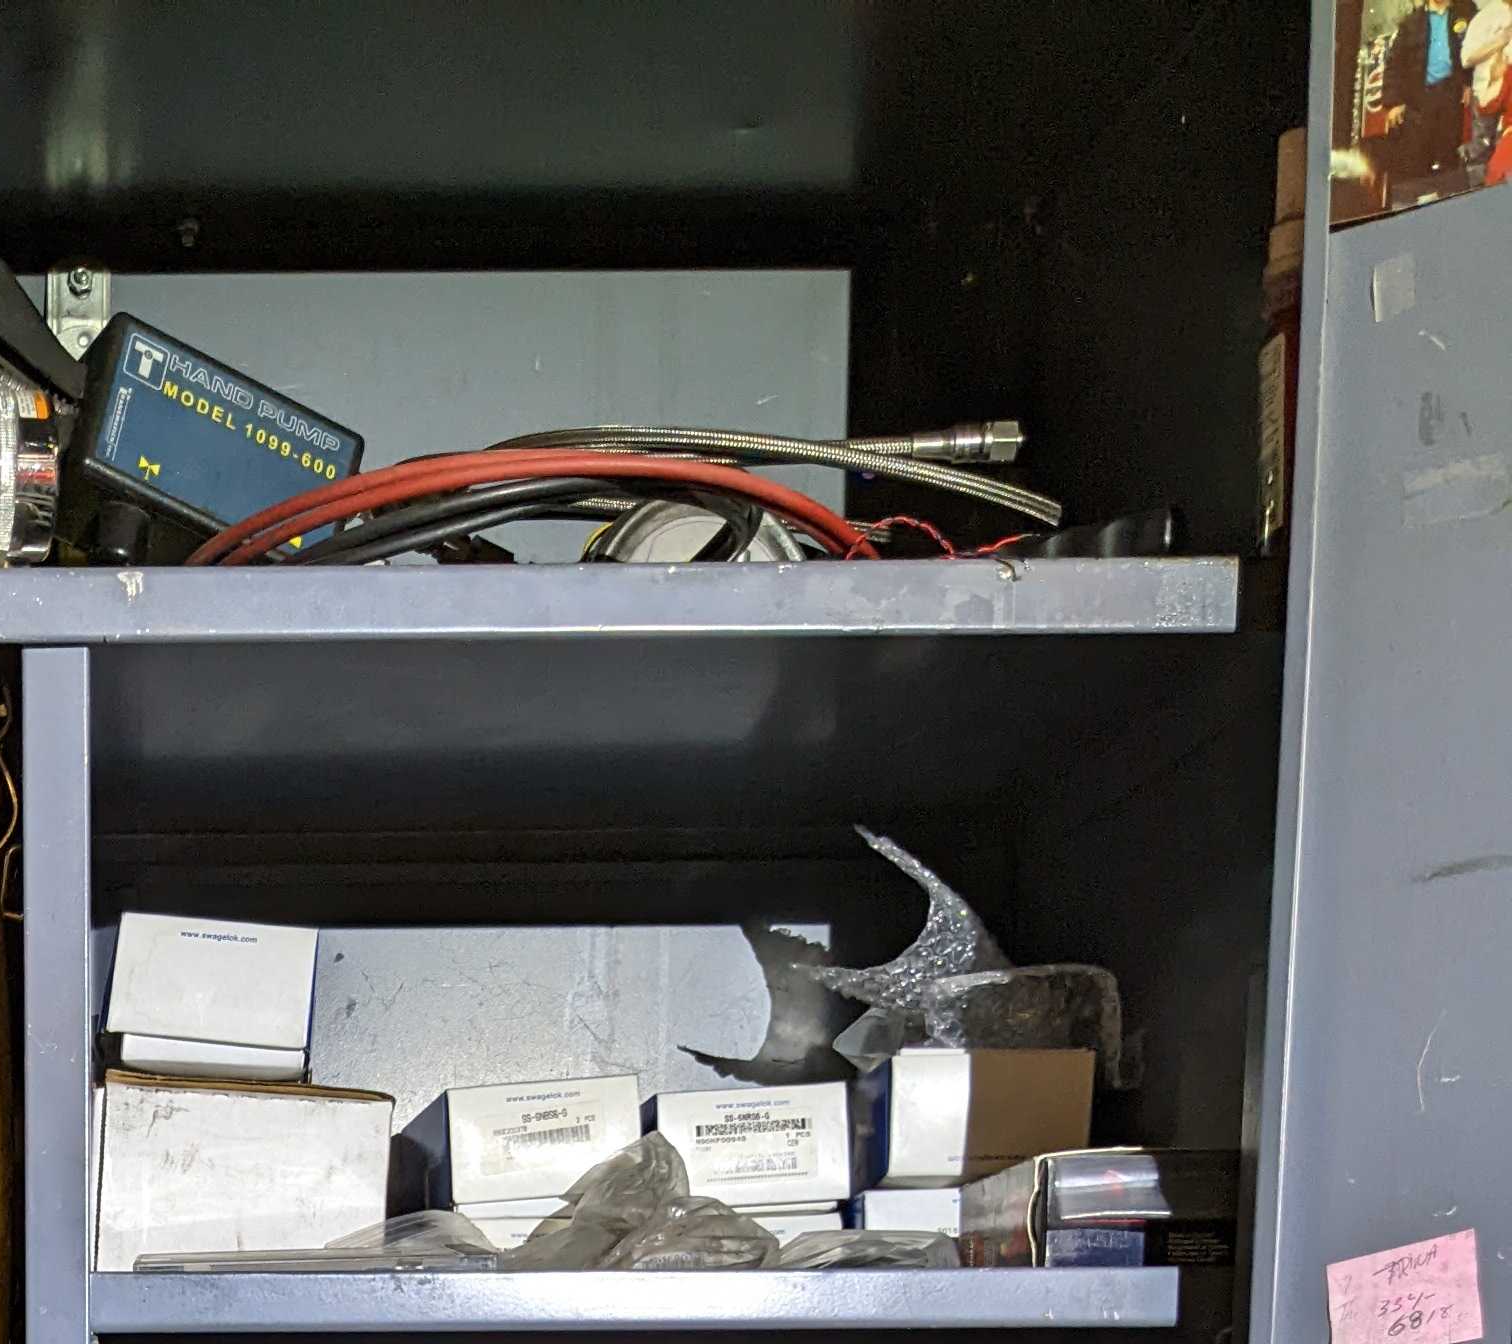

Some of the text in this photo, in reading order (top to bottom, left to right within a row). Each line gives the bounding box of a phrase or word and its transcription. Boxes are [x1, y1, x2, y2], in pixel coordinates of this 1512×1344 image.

[163, 380, 237, 431] MODEL
[244, 422, 337, 481] 1099-600
[169, 354, 255, 410] HAND
[257, 399, 341, 452] PUMP
